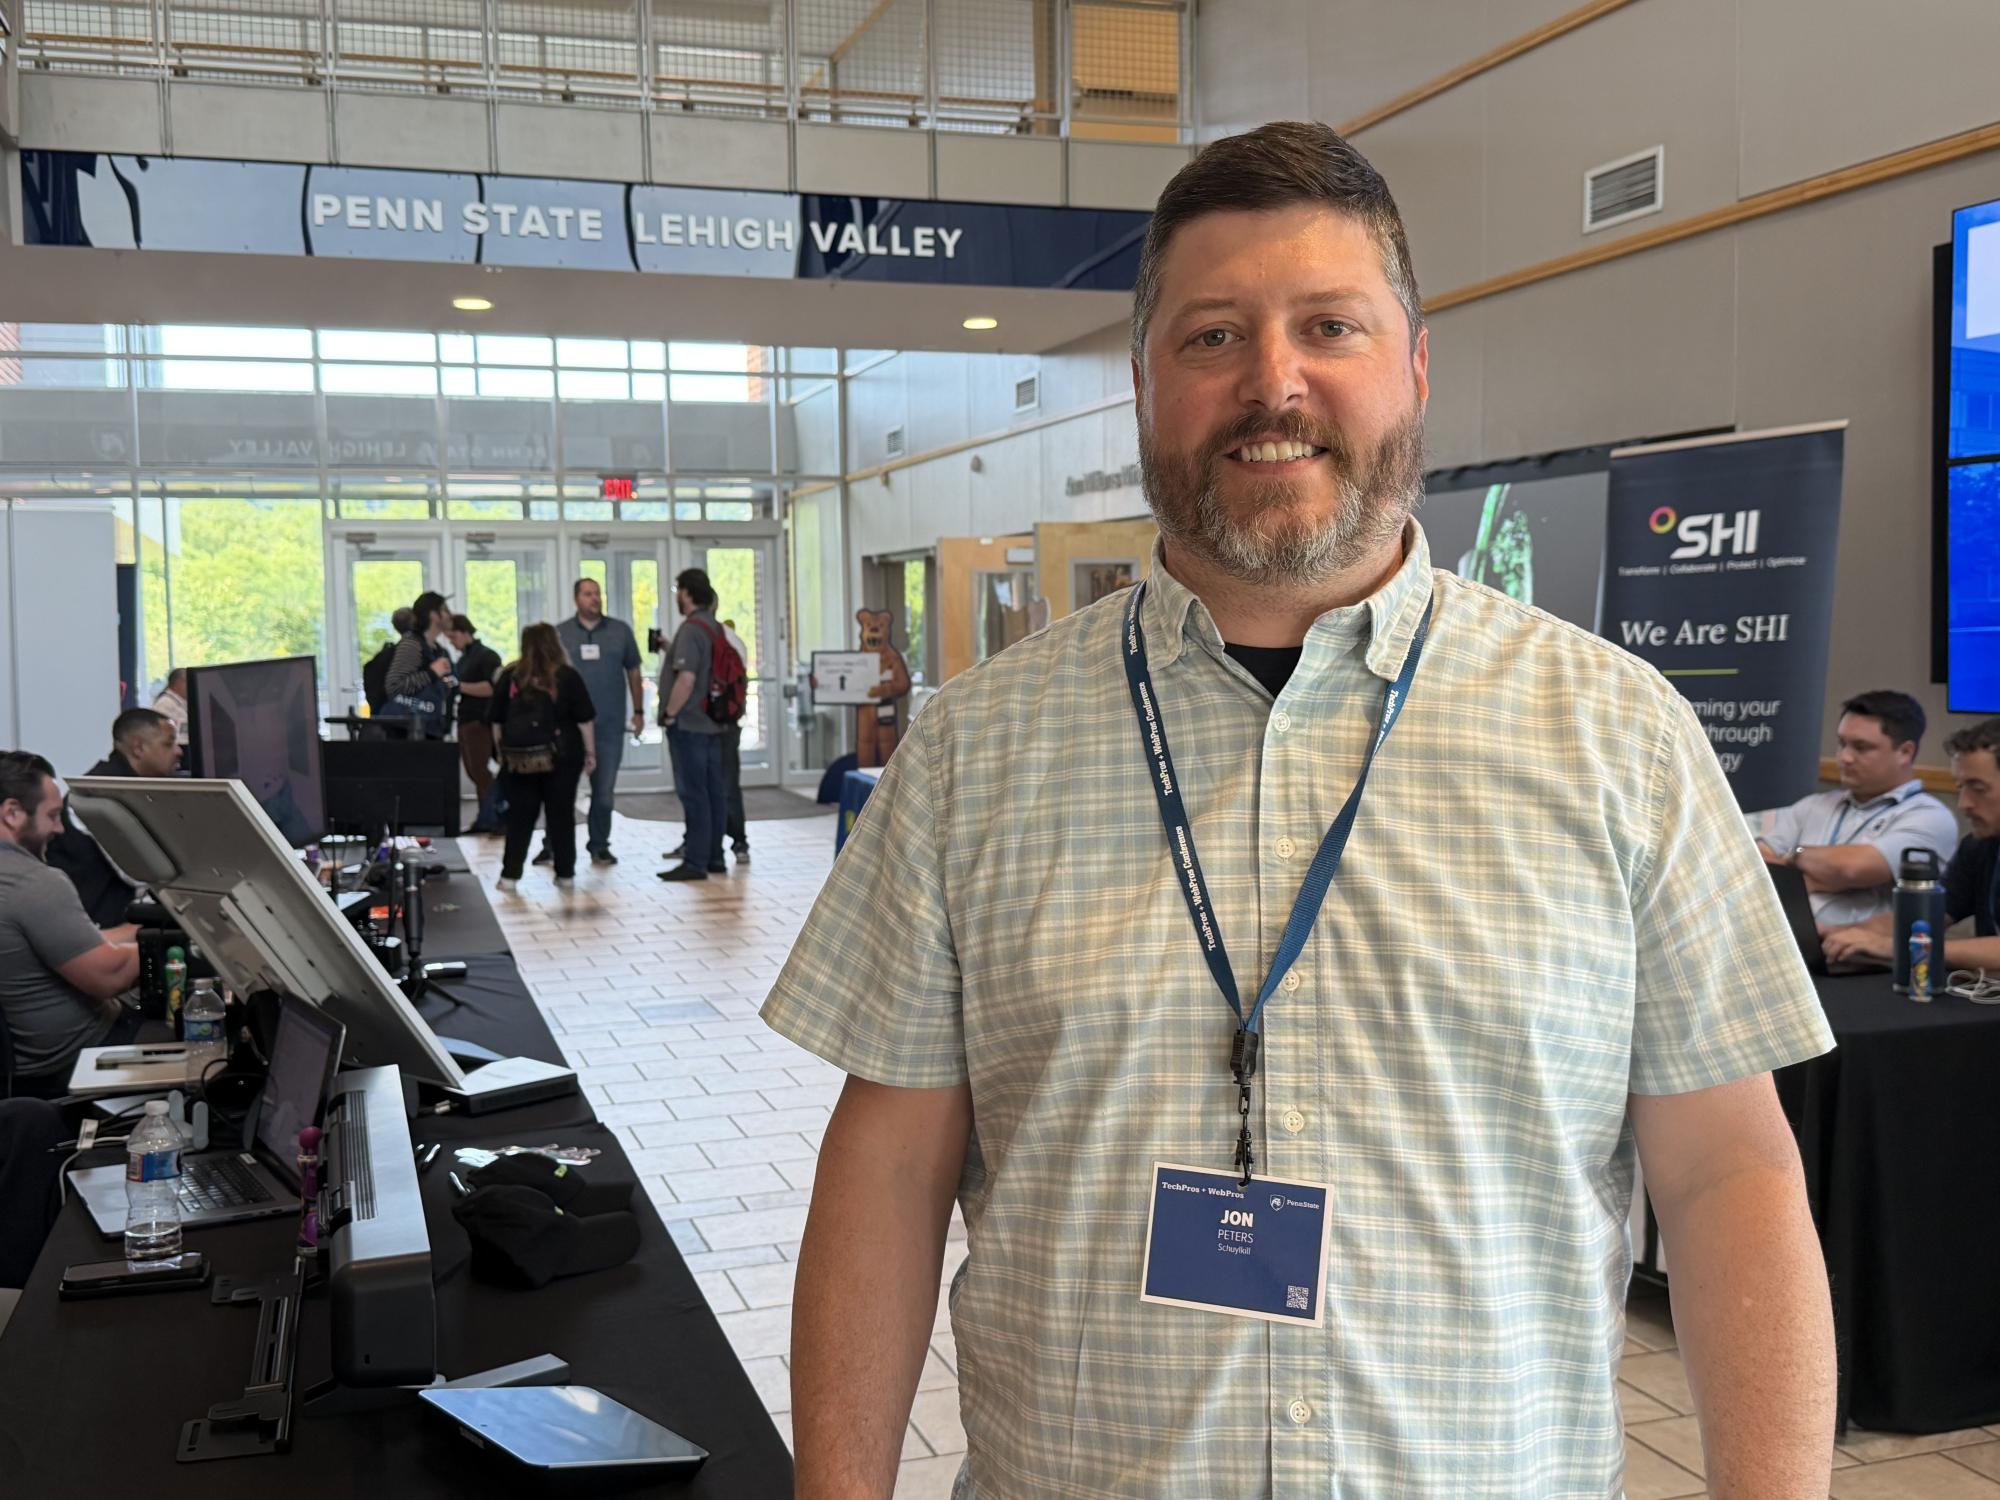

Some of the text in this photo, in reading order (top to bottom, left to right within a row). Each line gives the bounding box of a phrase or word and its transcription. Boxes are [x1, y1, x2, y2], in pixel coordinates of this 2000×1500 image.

[313, 193, 963, 259] PENN STATE LEHIGH VALLEY
[605, 479, 632, 499] EXIT
[1670, 509, 1760, 560] SHI
[1620, 614, 1790, 647] We Are SHI
[1138, 681, 1155, 722] Conference
[1738, 700, 1781, 721] your
[1150, 720, 1163, 756] WebPros
[1158, 760, 1173, 796] TechPros
[1176, 826, 1192, 868] Conference
[1187, 869, 1203, 906] WebPros
[1200, 911, 1216, 951] TechPros
[1162, 1182, 1200, 1193] TechPros
[1208, 1187, 1245, 1199] WebPros
[1286, 1199, 1320, 1210] PennState
[1220, 1209, 1254, 1228] JON
[1217, 1229, 1254, 1244] PETERS
[1217, 1243, 1251, 1256] Schuylkill
